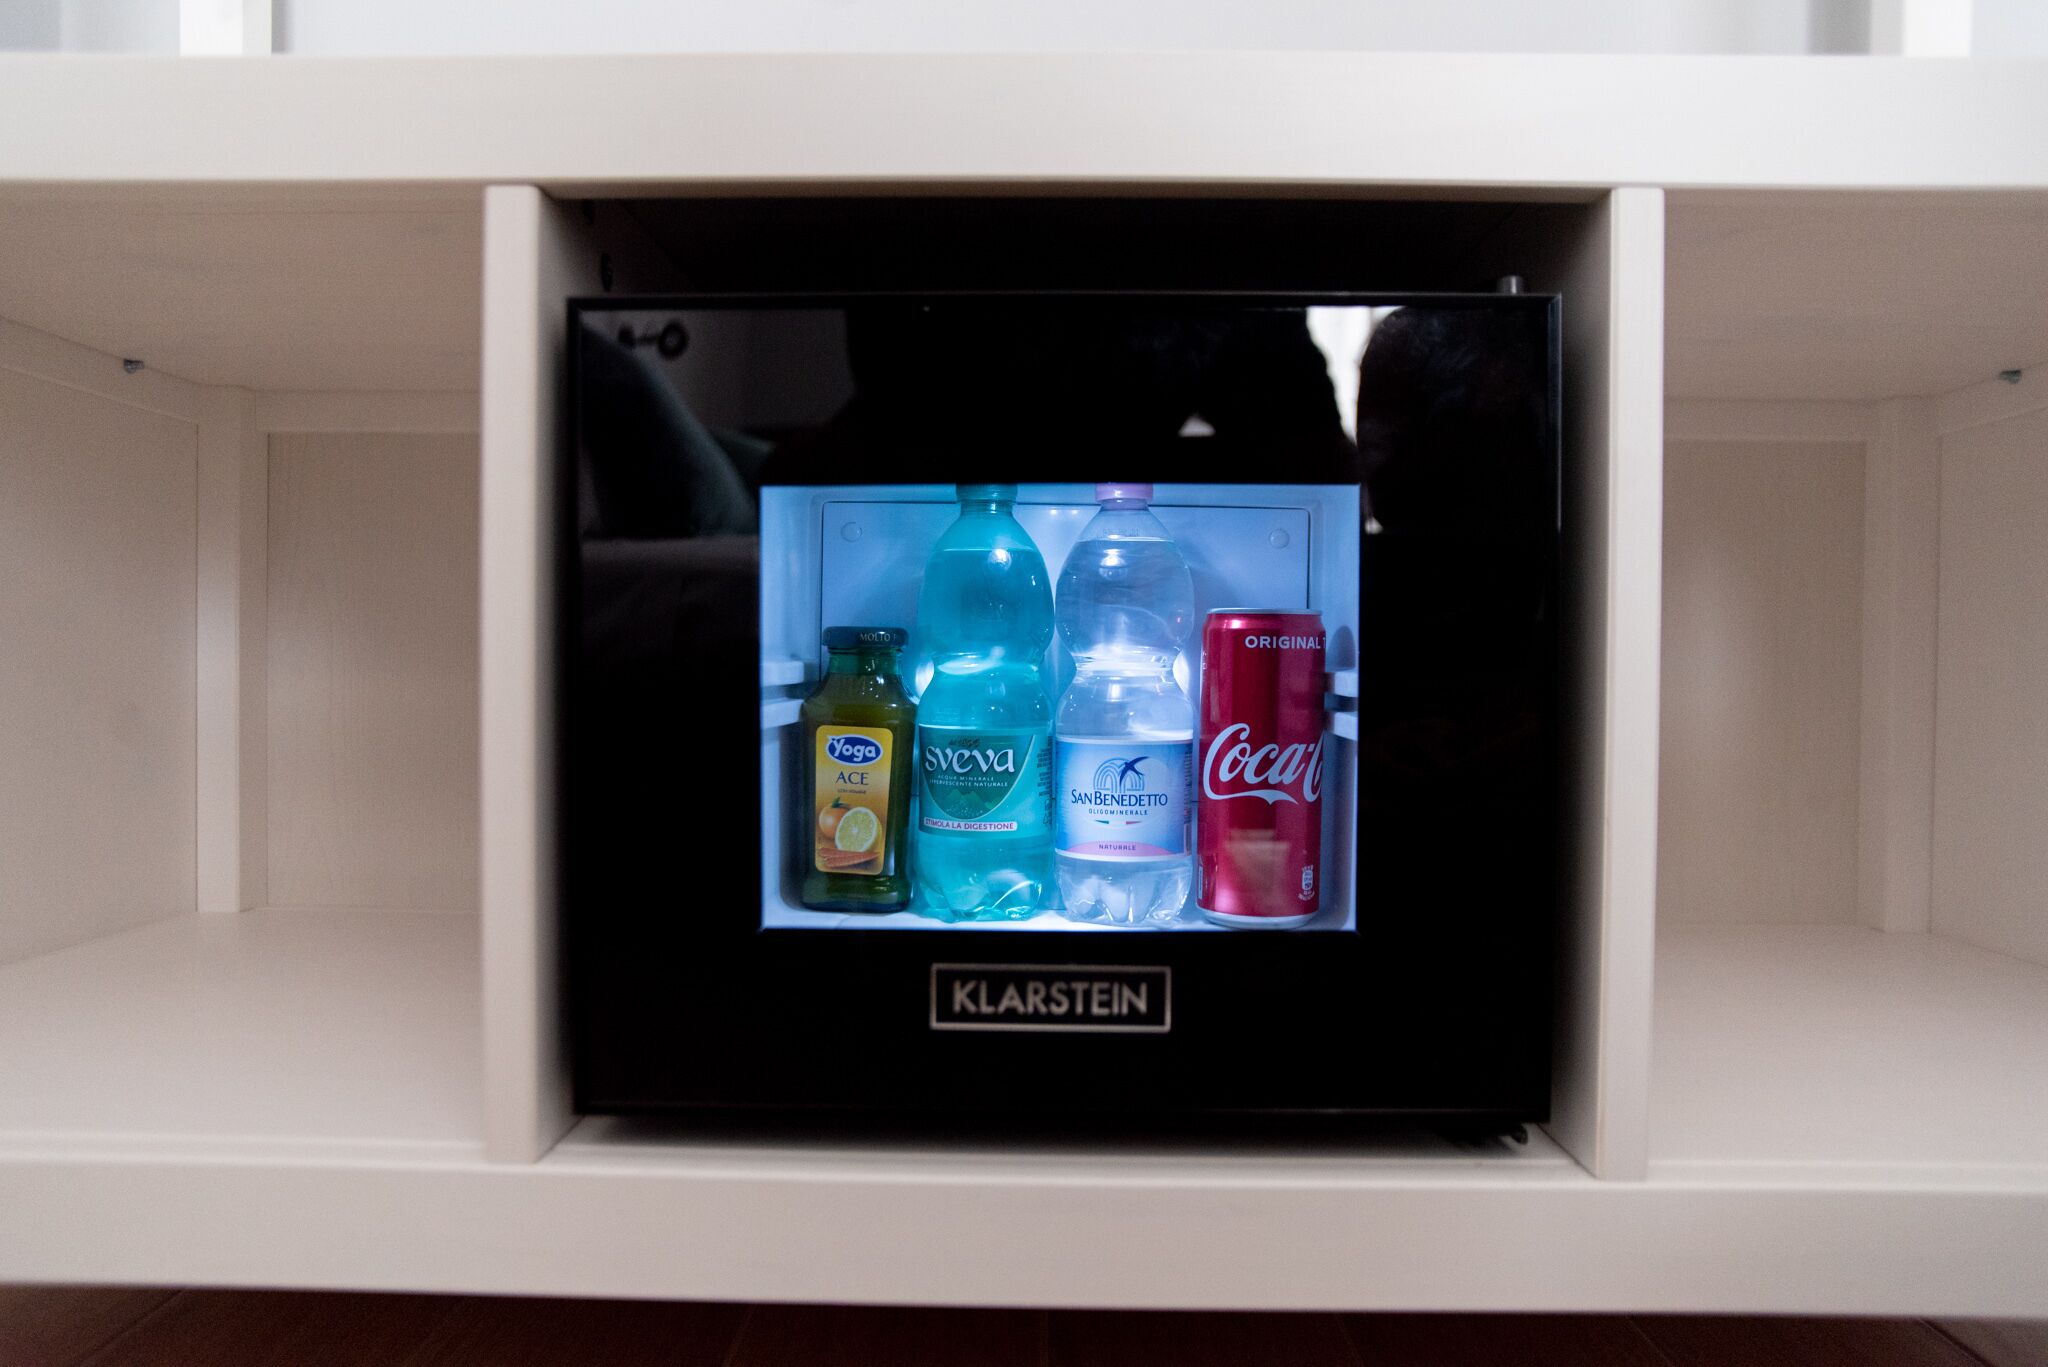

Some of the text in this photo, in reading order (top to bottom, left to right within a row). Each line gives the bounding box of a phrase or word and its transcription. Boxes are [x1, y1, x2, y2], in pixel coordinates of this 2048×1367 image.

[859, 632, 891, 642] MOLTO
[1244, 635, 1321, 649] ORIGINAL
[832, 738, 877, 761] Yoga
[835, 771, 869, 785] ACE
[1088, 808, 1148, 816] OLIGOMINERALE
[925, 818, 1014, 830] STIMOLA LA DIGESTIONE
[952, 979, 1148, 1016] KLARSTEIN
